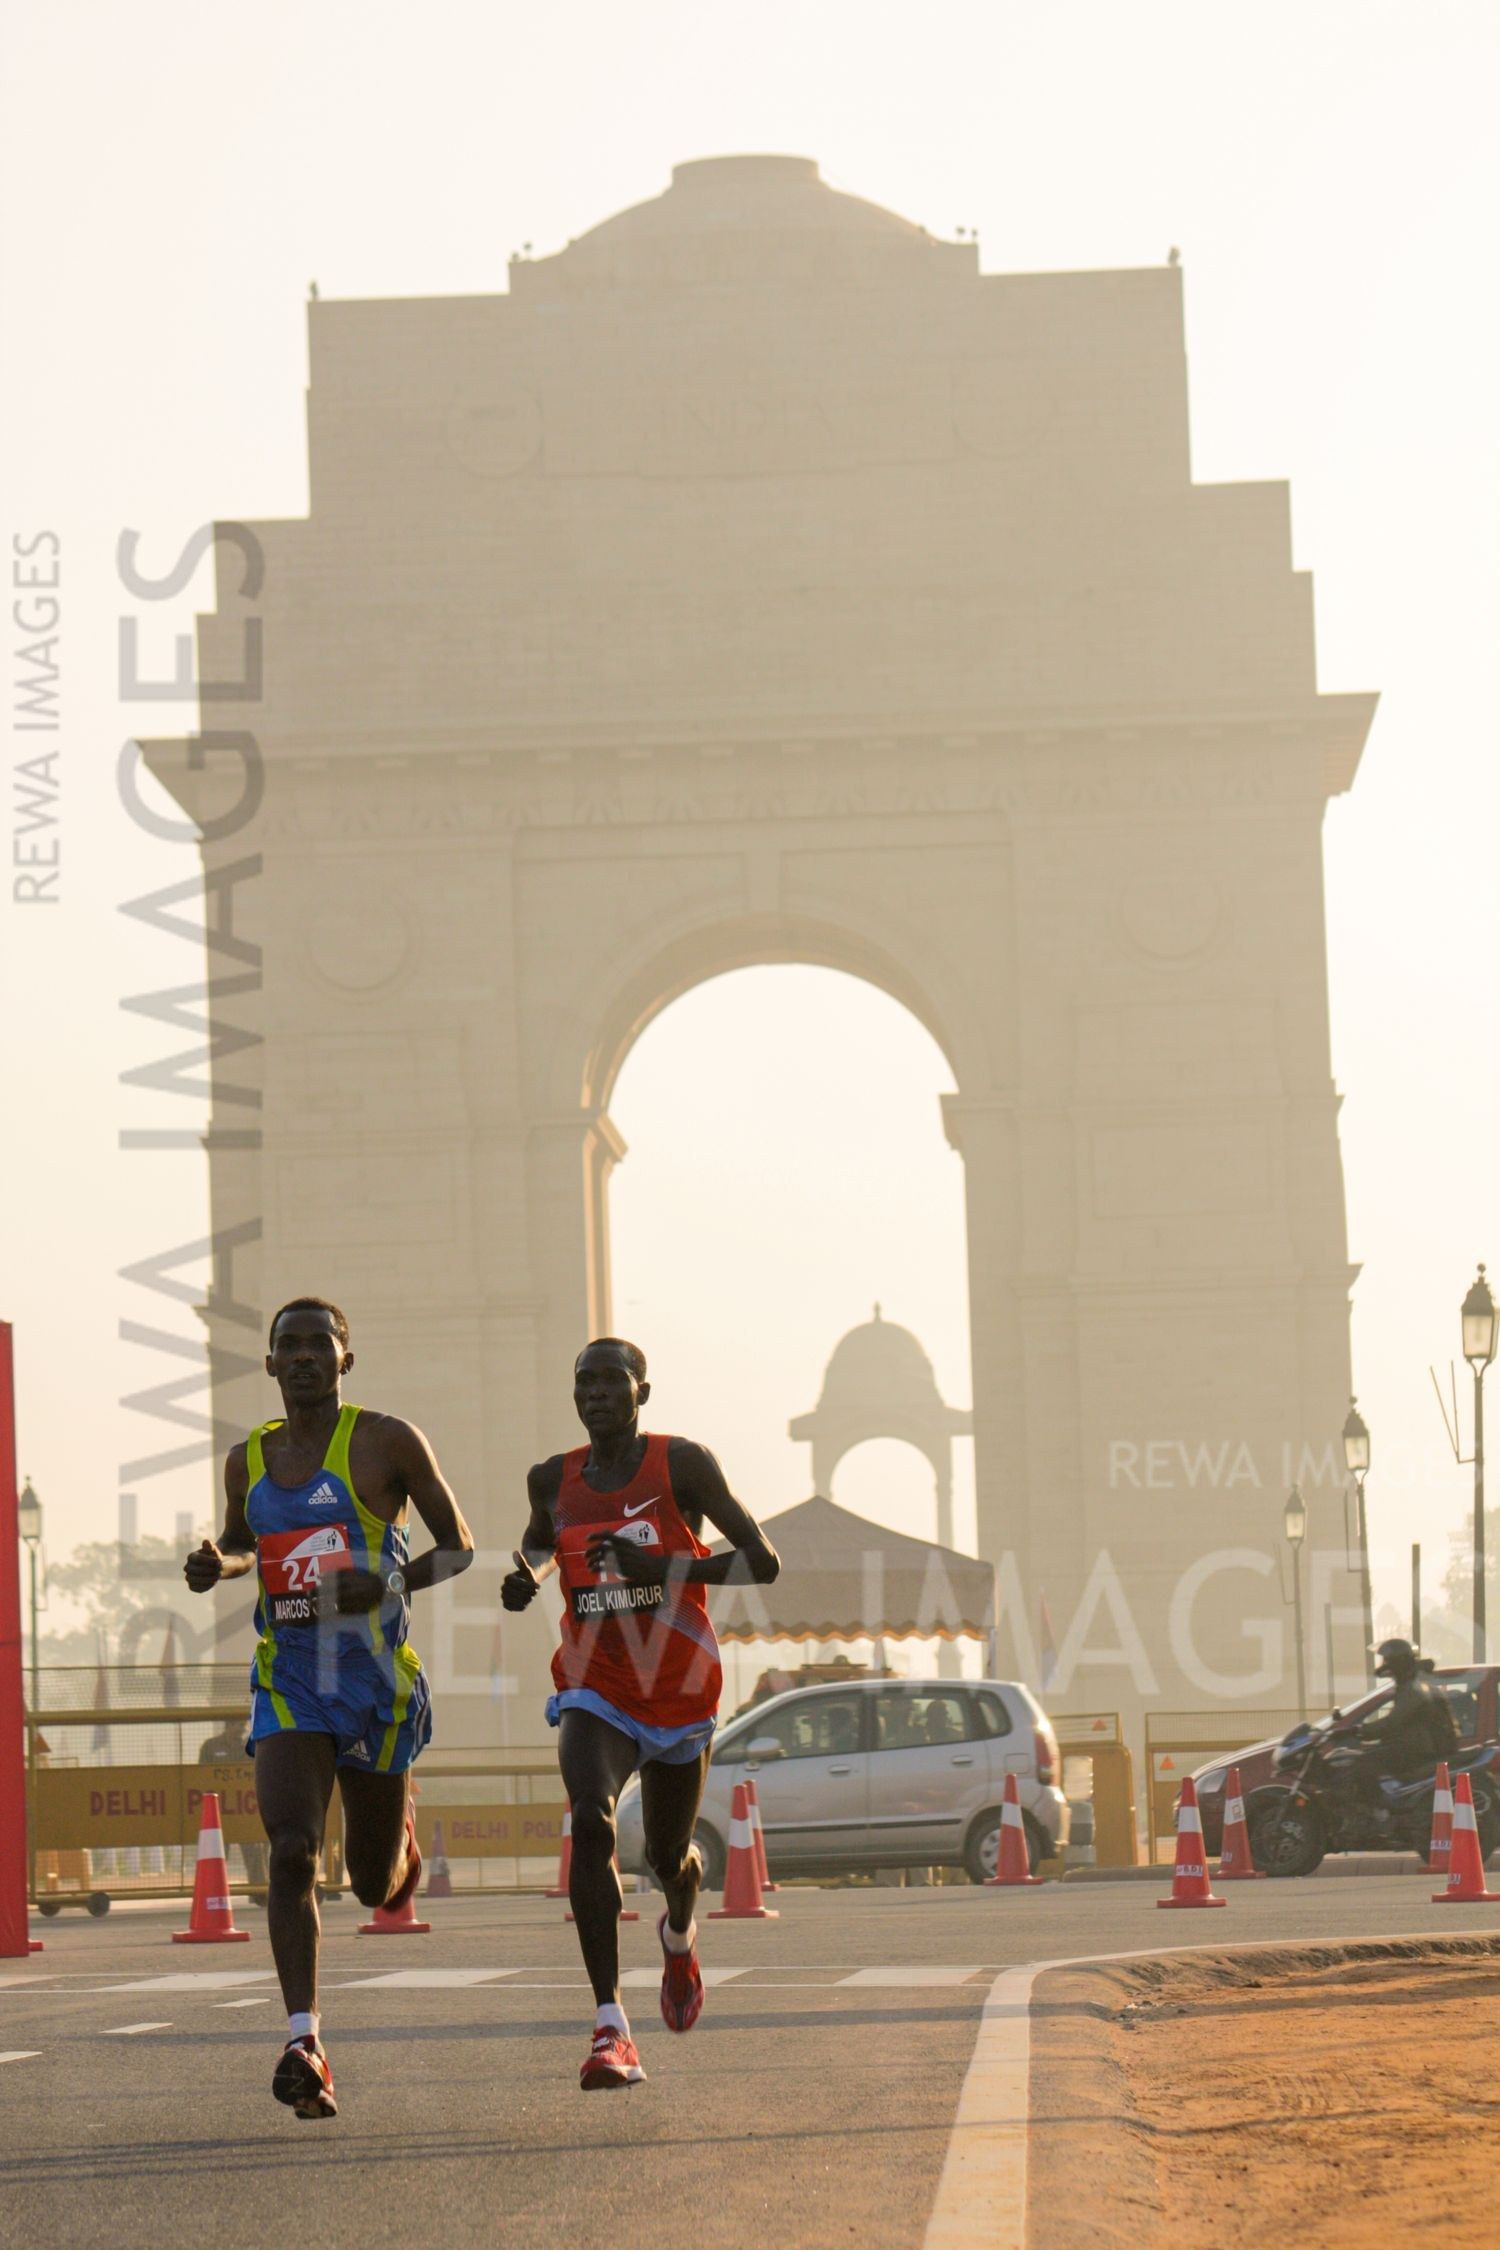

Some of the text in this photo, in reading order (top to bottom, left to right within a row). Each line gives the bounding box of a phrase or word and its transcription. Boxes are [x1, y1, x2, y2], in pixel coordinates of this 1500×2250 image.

[308, 1494, 338, 1505] adidas
[282, 1556, 322, 1591] 24
[275, 1598, 310, 1620] MARCOS
[577, 1585, 664, 1614] JOEL KIMURUR
[89, 1790, 166, 1817] DELHI
[452, 1811, 508, 1839] DELHI
